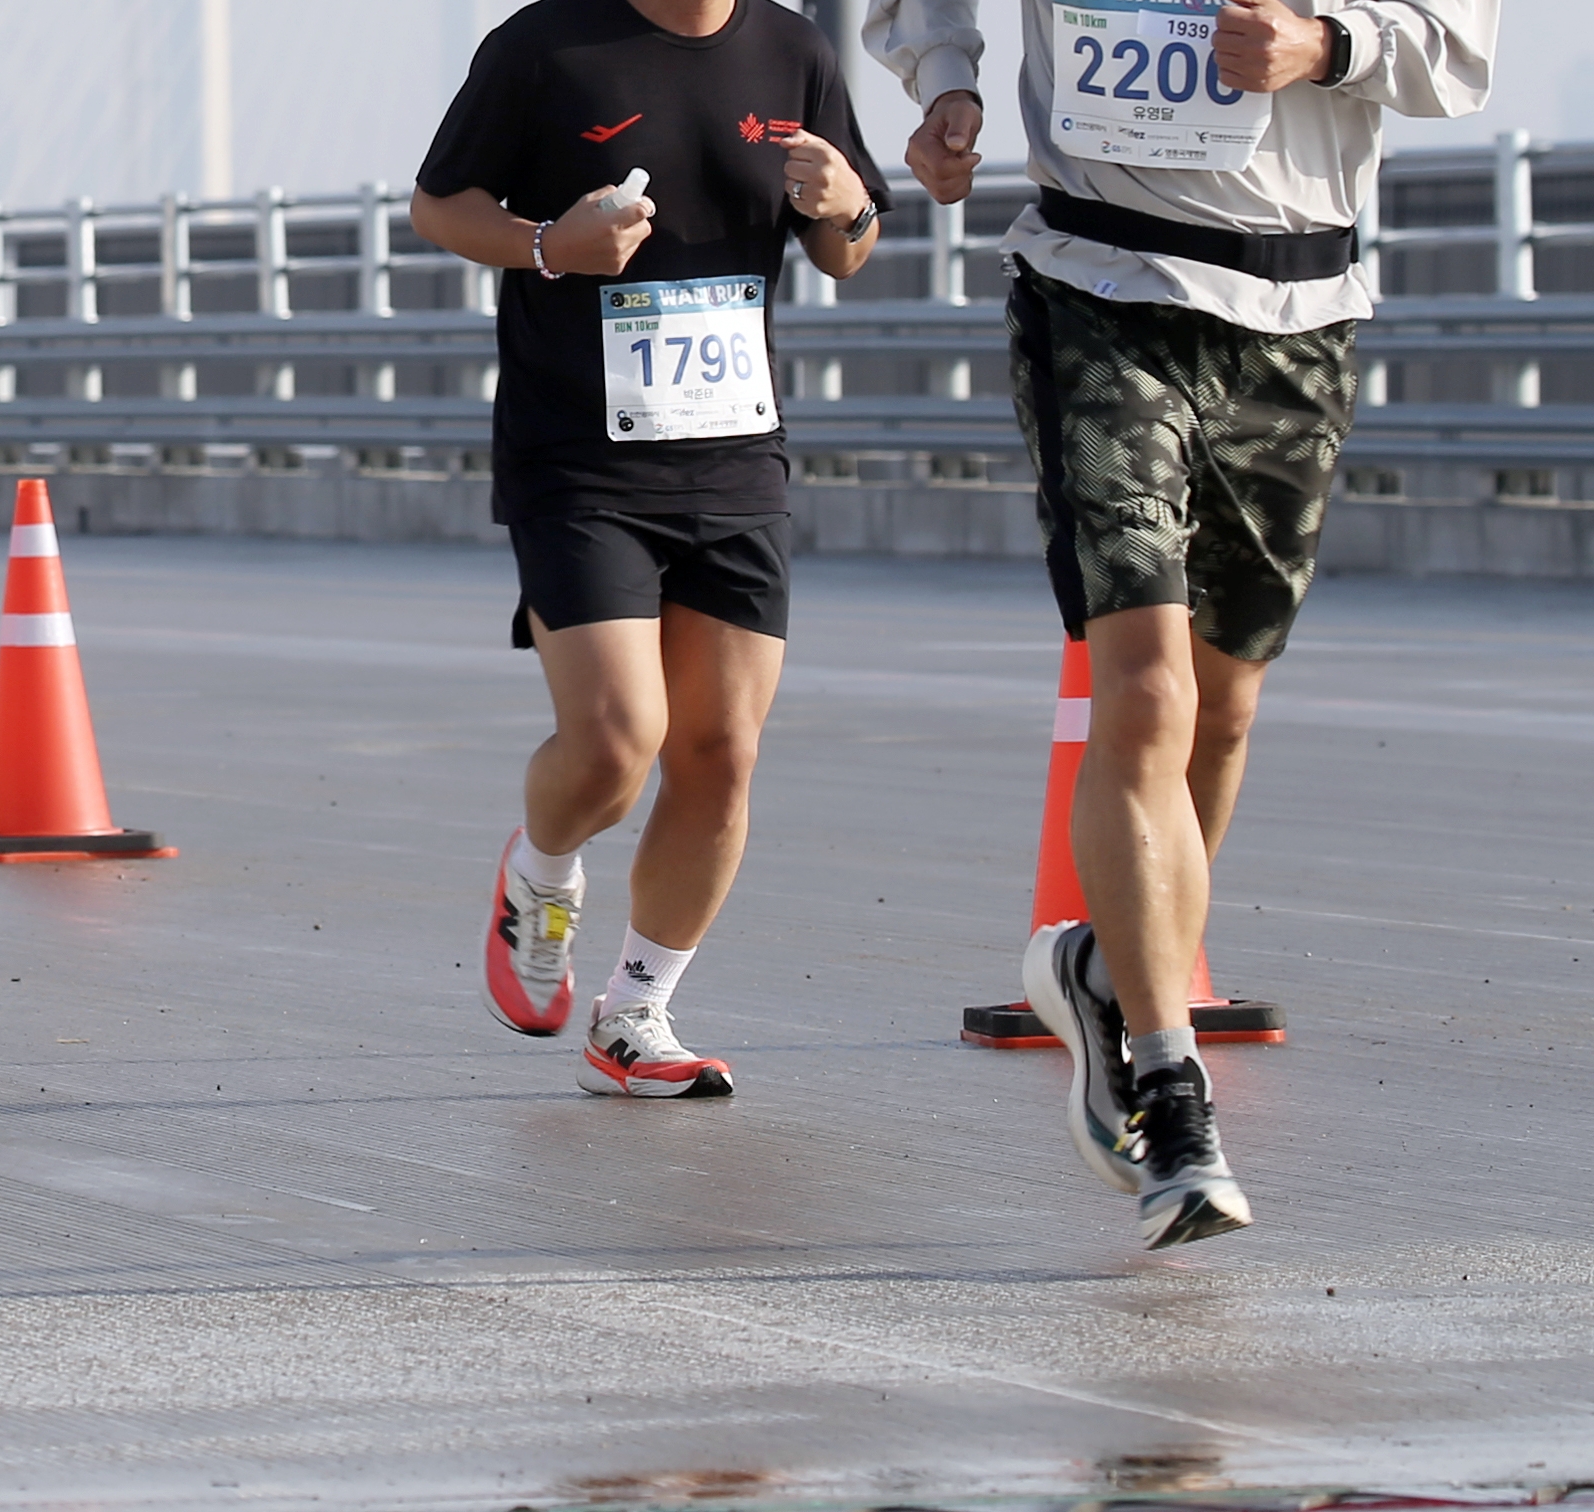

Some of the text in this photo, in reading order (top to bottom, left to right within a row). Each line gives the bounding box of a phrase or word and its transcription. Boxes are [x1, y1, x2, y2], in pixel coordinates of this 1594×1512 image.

[1080, 13, 1107, 29] 10km
[1167, 19, 1210, 40] 1939
[1132, 105, 1175, 122] 유영달
[613, 292, 652, 309] 025
[614, 320, 659, 333] RUN 10km
[630, 331, 753, 388] 1796
